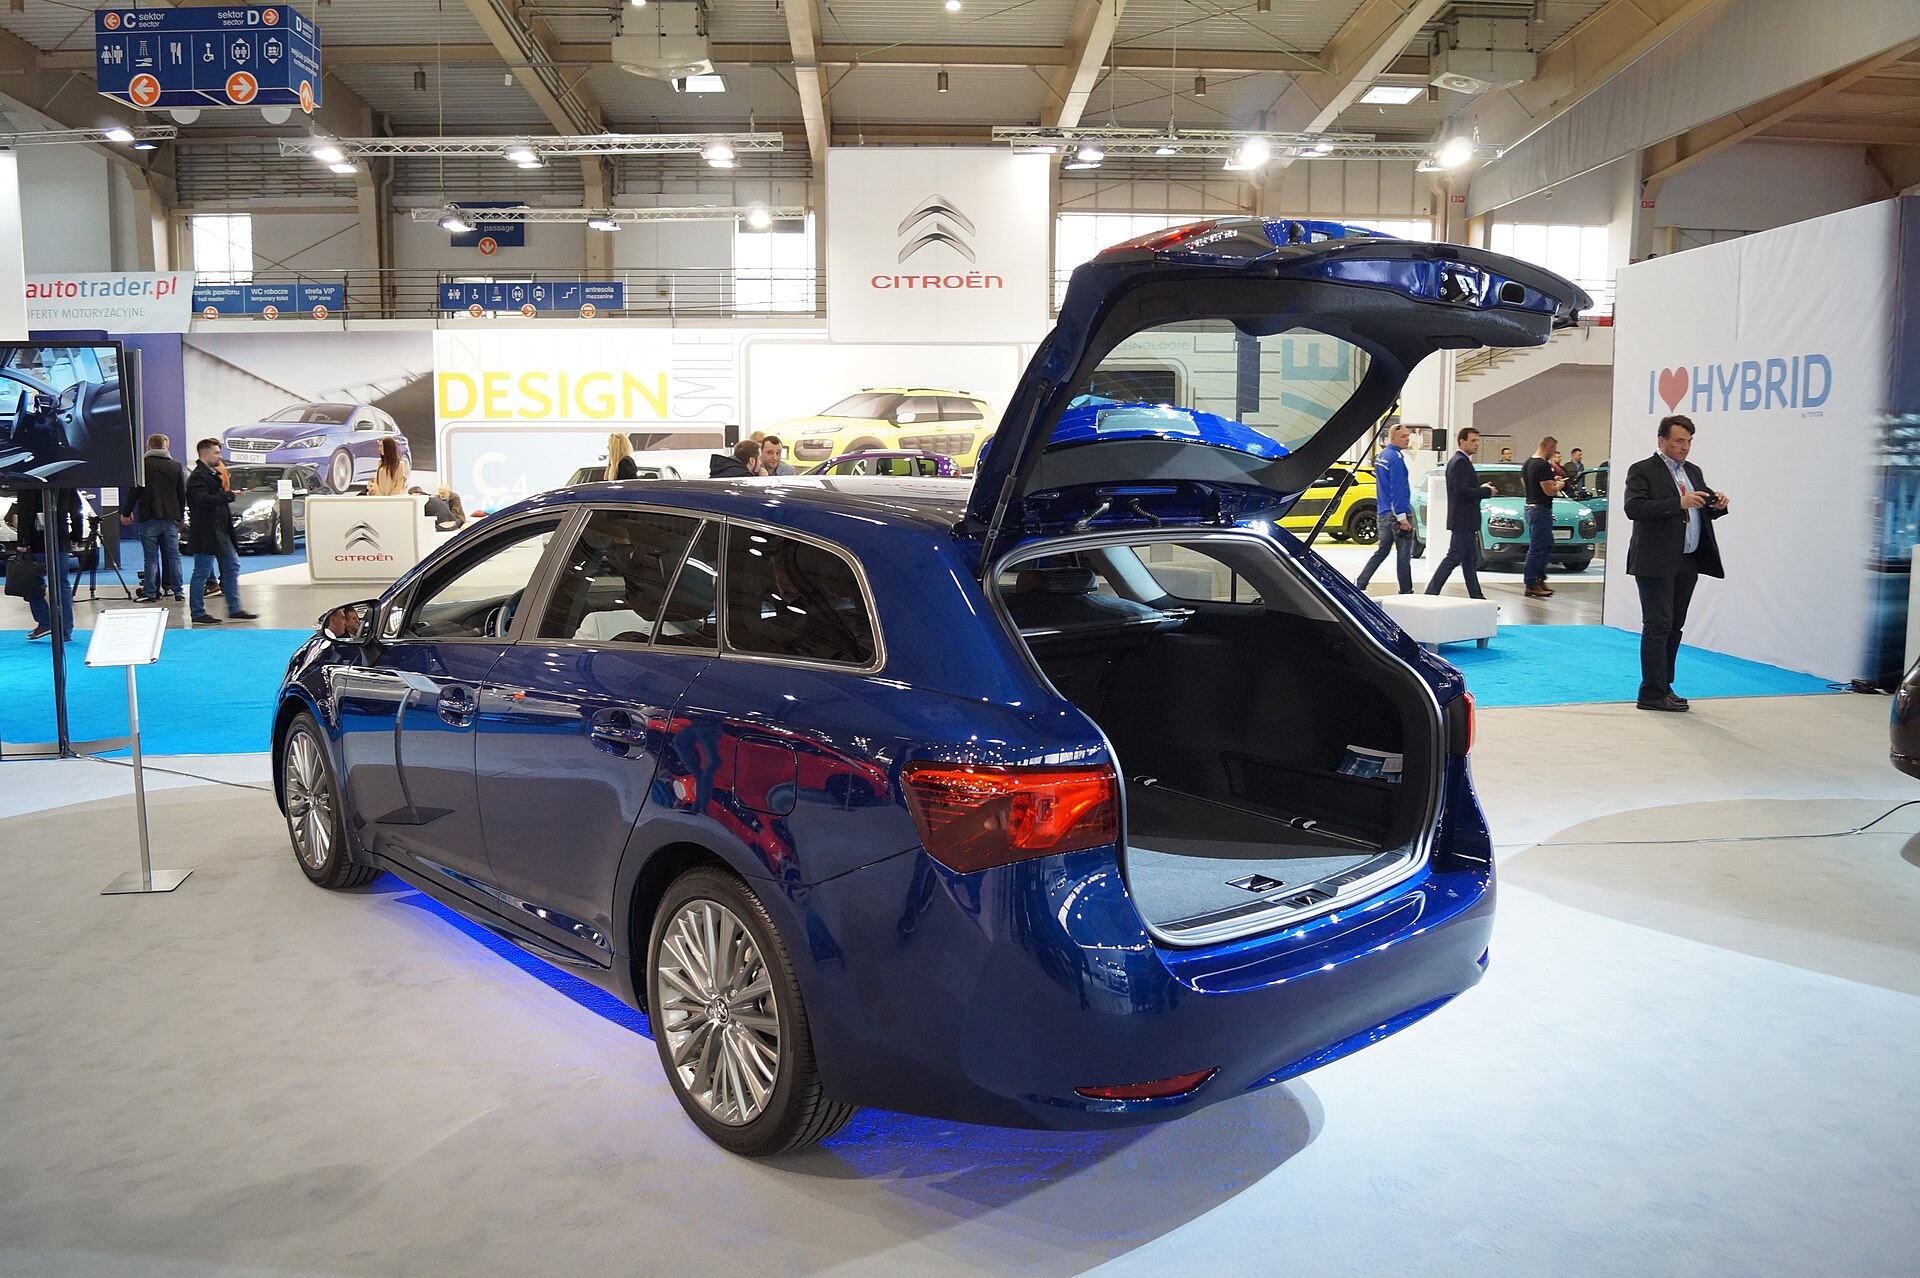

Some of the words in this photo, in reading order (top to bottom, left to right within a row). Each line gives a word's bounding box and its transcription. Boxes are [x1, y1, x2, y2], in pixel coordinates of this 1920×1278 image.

[123, 12, 136, 29] C
[138, 12, 165, 21] sektor
[217, 11, 244, 19] sektor
[247, 10, 260, 25] D
[26, 275, 177, 300] autotrader.pl
[251, 287, 263, 295] WC
[62, 307, 145, 319] MOTORYZACYJNE
[1648, 370, 1656, 415] I
[1691, 353, 1832, 413] HYBRID
[438, 371, 668, 419] DESIGN
[236, 453, 249, 461] 308
[250, 454, 260, 462] GT
